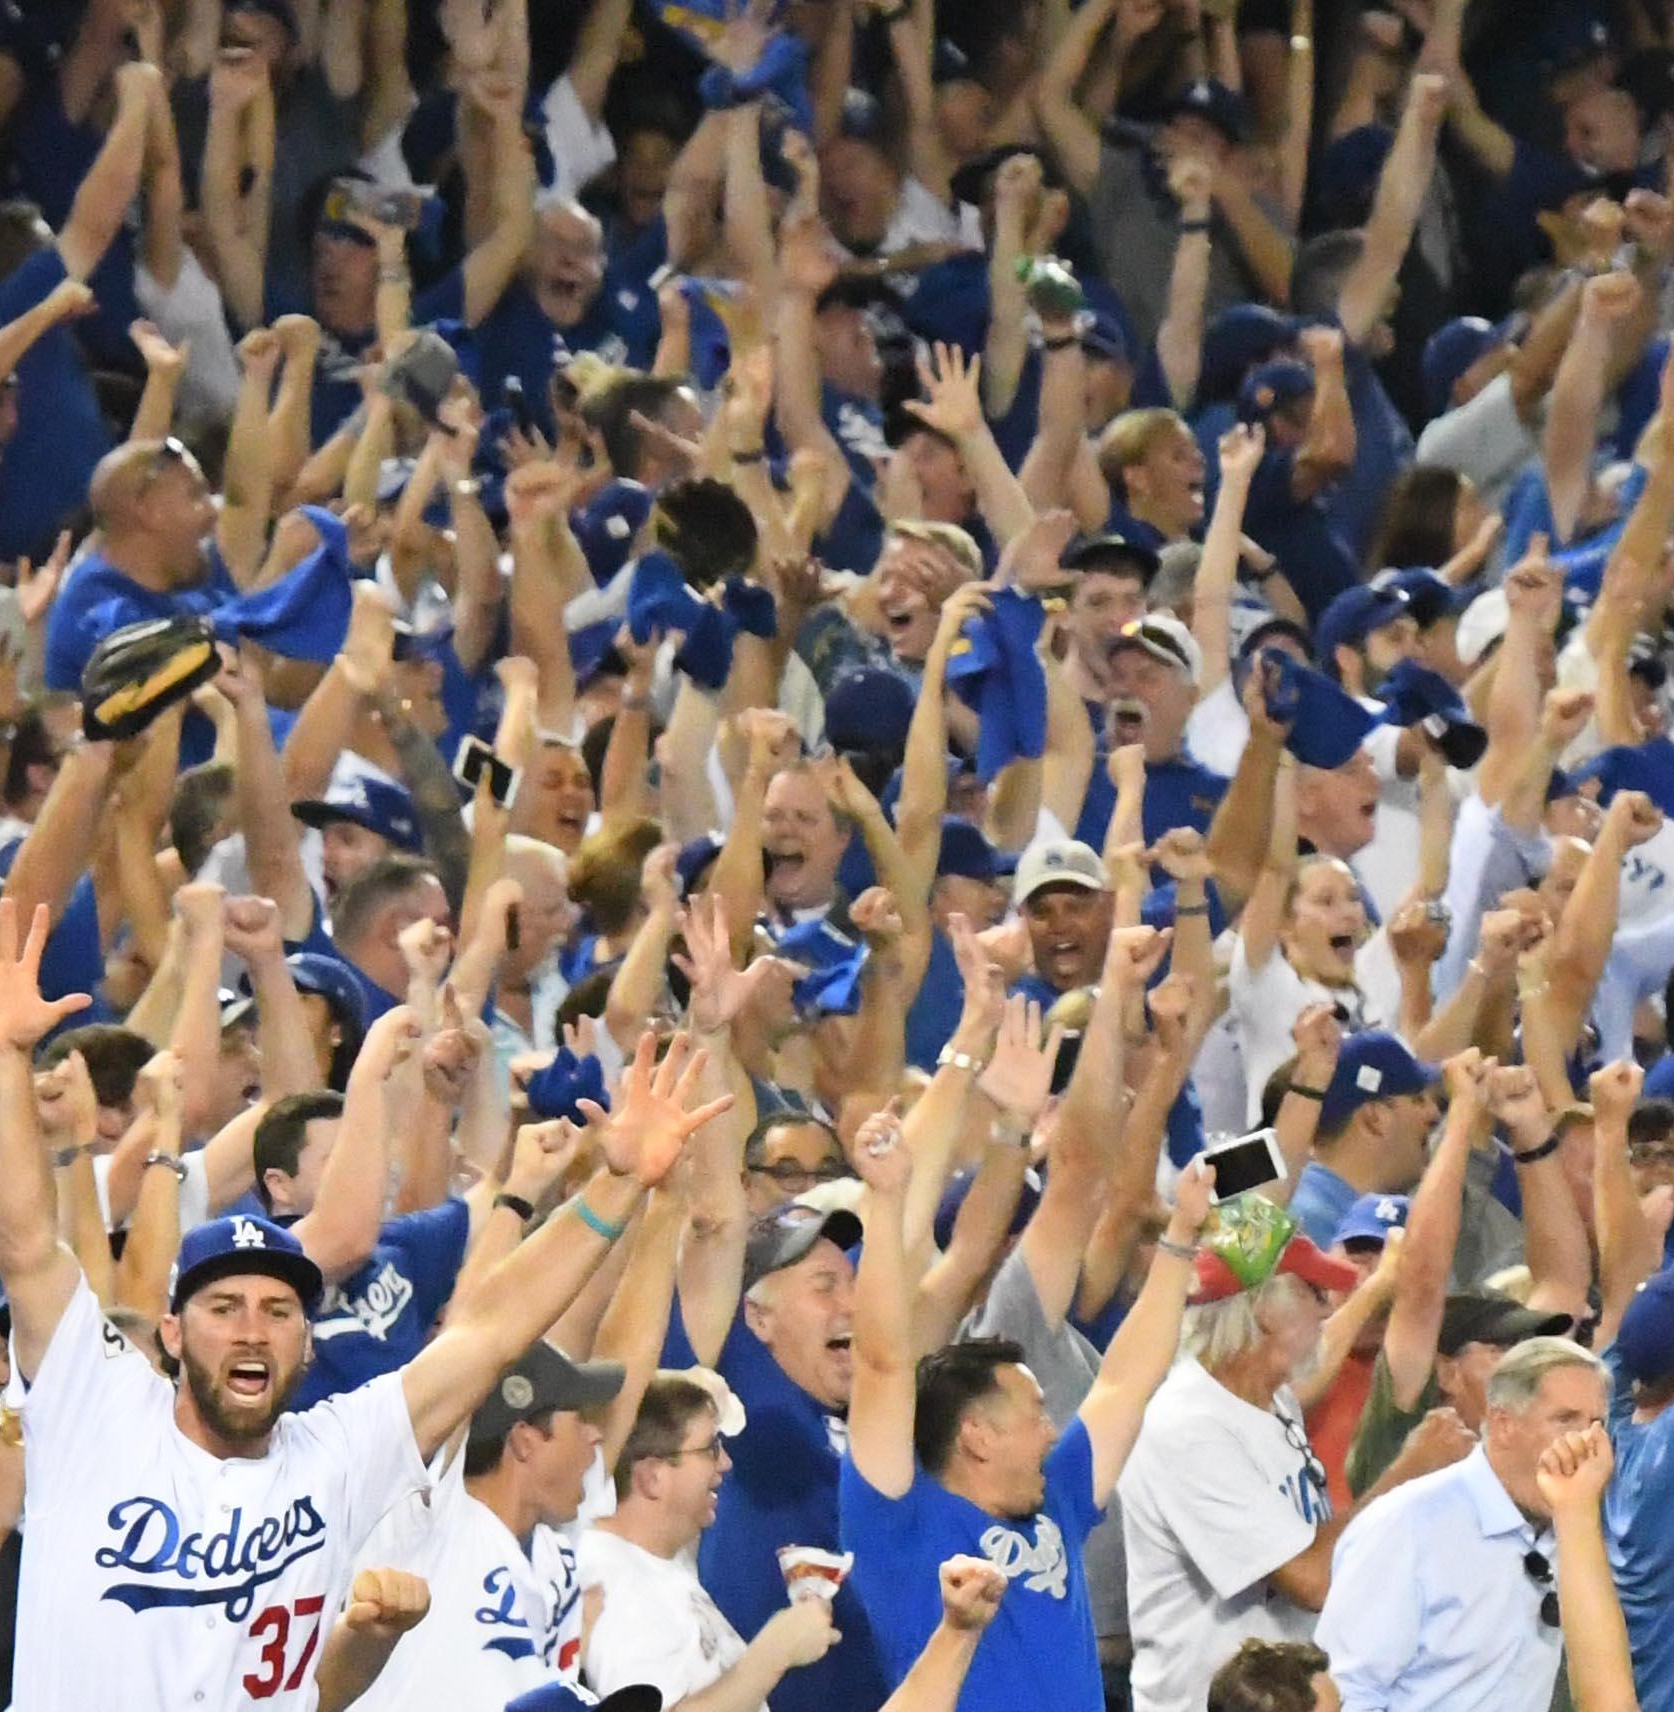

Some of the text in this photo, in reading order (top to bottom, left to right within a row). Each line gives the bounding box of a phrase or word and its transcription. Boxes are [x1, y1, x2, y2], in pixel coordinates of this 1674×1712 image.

[229, 1215, 266, 1249] LA
[95, 1495, 326, 1623] Dodgers
[243, 1594, 326, 1700] 37
